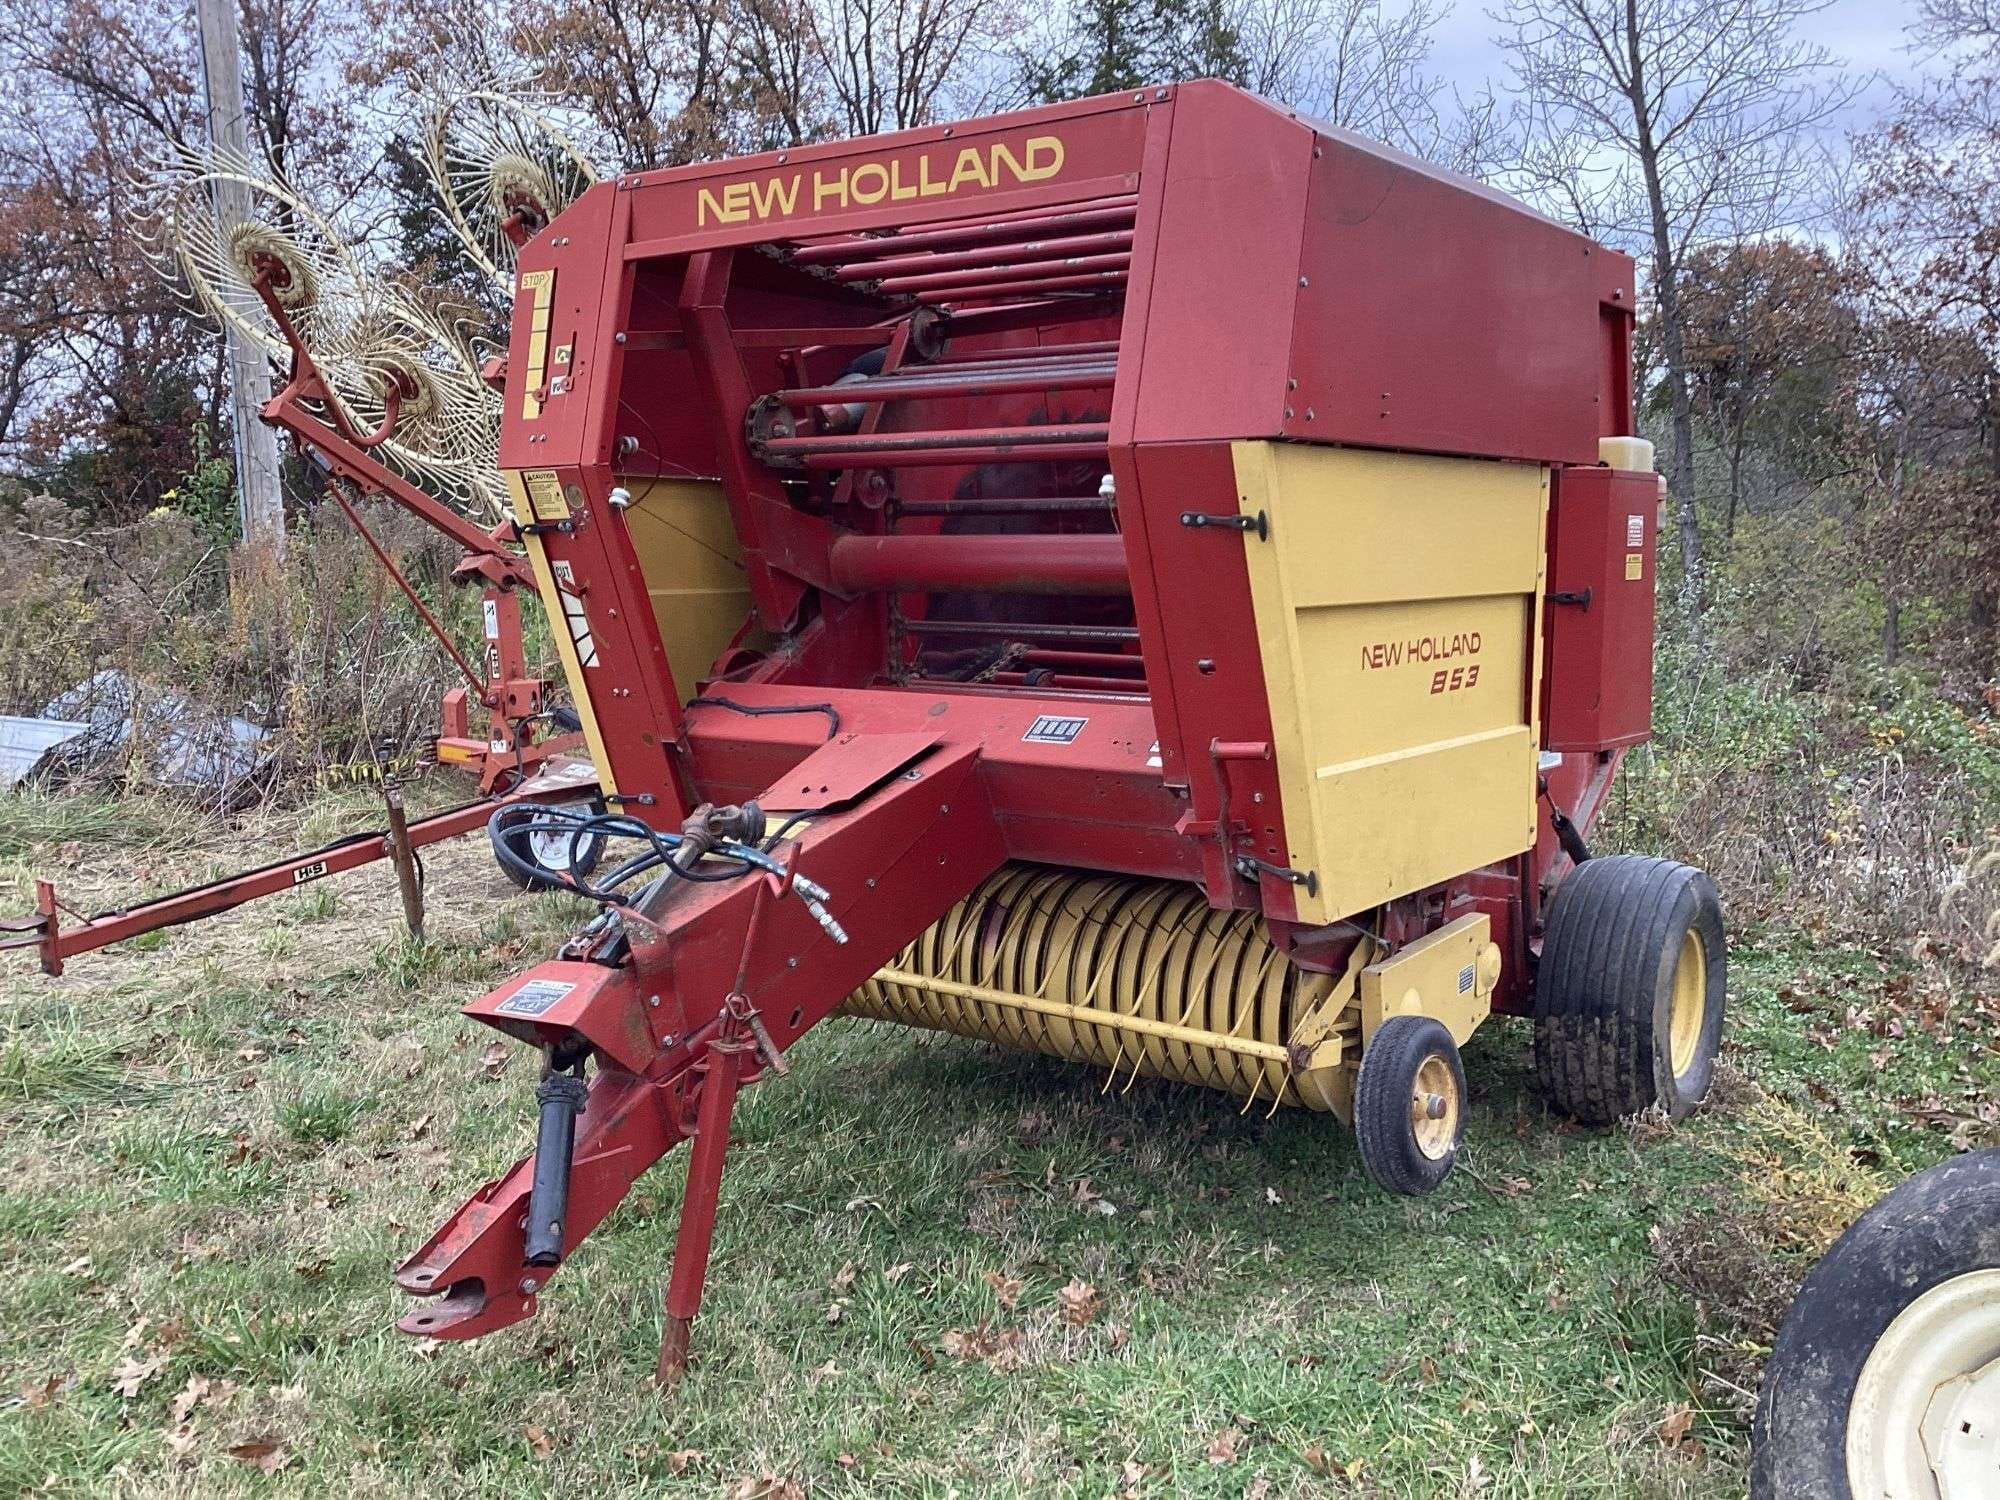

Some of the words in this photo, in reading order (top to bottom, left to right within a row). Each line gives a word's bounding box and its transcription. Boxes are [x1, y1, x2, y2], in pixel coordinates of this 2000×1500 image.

[698, 174, 800, 226] NEW
[813, 136, 1065, 212] HOLLAND
[523, 273, 545, 286] STOP
[532, 472, 556, 480] CAUTION
[555, 566, 570, 578] CUT
[1361, 641, 1403, 670] NEW
[1407, 632, 1481, 663] HOLLAND
[1430, 664, 1480, 694] 853
